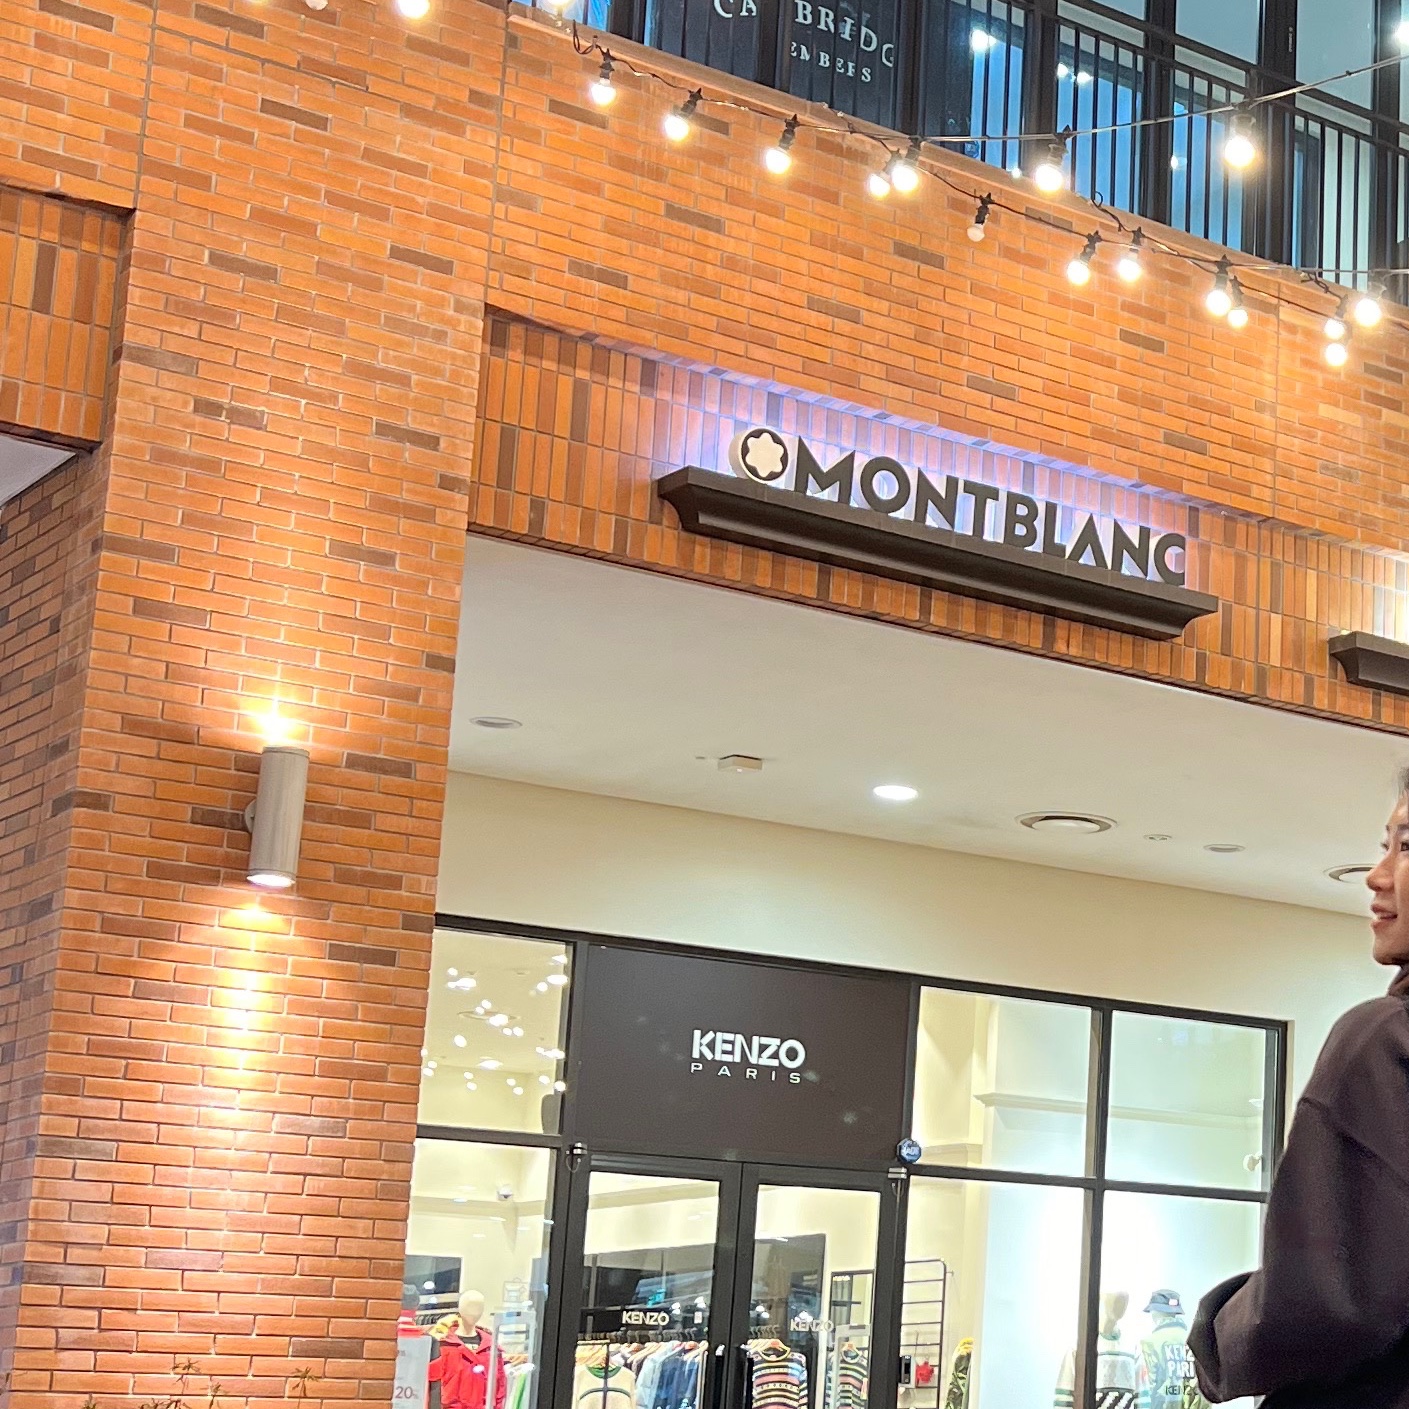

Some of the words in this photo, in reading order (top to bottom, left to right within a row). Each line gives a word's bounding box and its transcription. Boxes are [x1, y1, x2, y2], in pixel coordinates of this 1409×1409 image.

[798, 434, 1187, 587] MONTBLANC
[691, 1028, 806, 1069] KENZO
[690, 1062, 802, 1084] PARIS
[621, 1310, 671, 1326] KENZO
